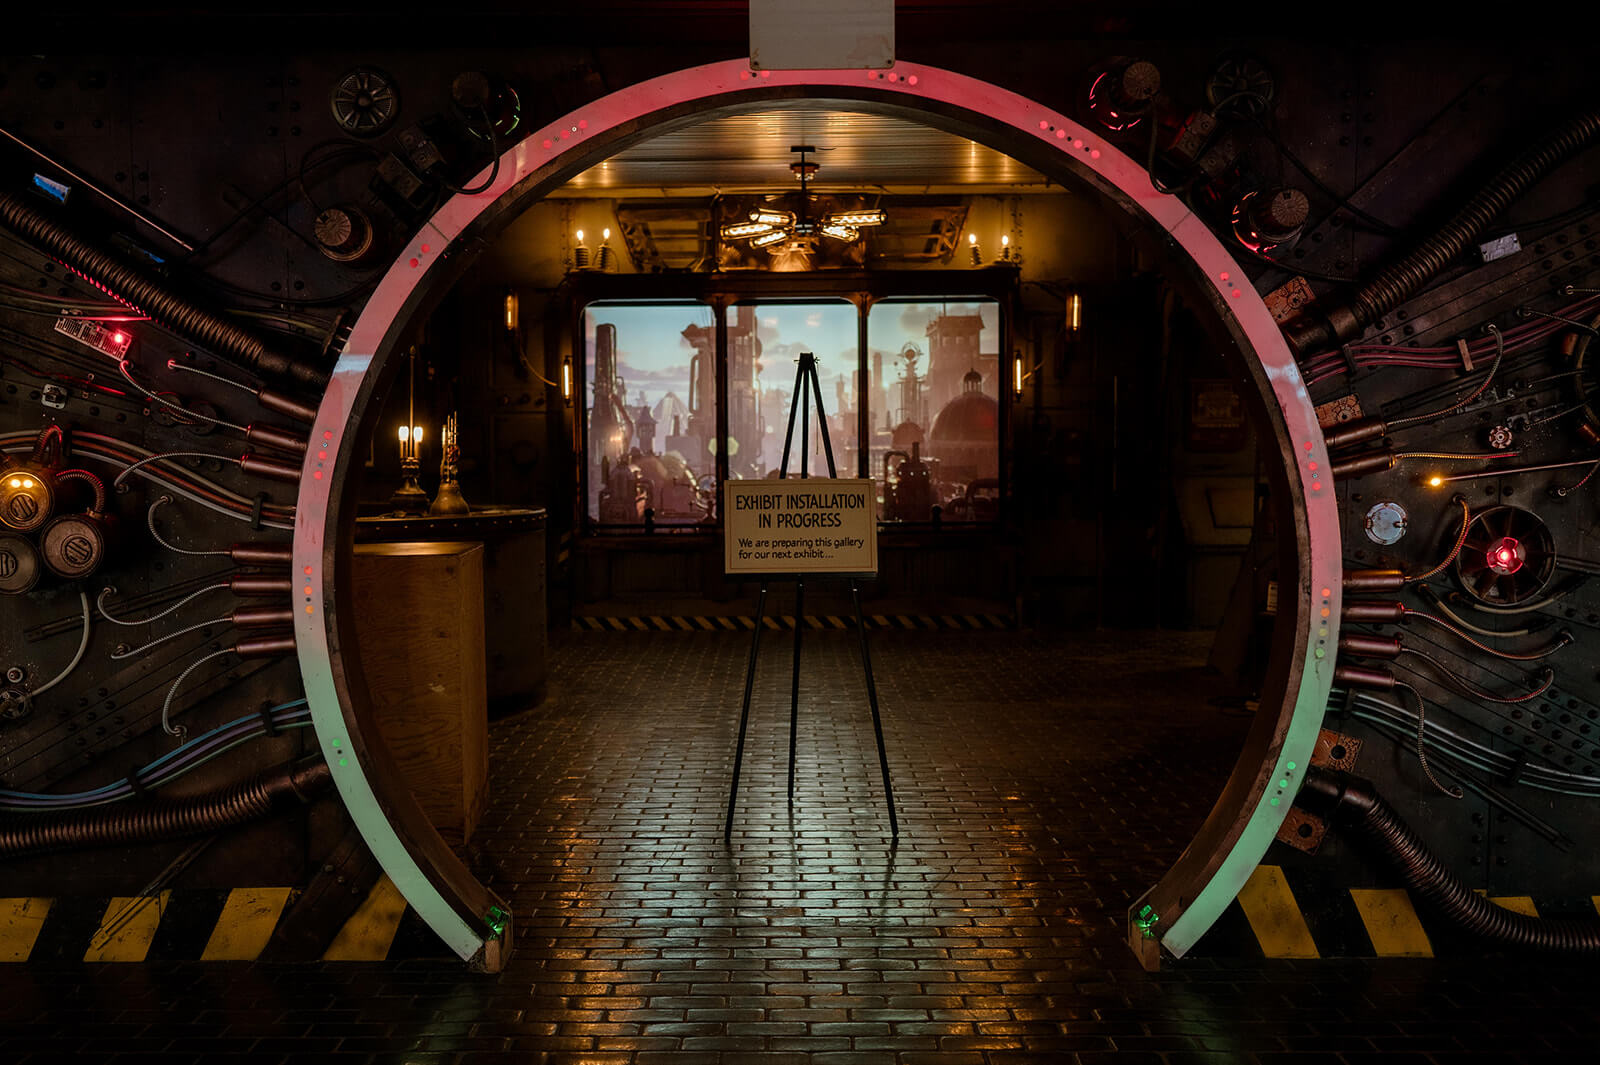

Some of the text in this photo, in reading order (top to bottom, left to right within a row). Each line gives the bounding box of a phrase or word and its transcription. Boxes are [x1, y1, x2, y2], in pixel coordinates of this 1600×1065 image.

[736, 494, 865, 510] EXHIBIT INSTALLATION
[758, 513, 842, 528] IN PROGRESS
[738, 536, 864, 550] We are preparing this gallery
[738, 550, 752, 559] for
[754, 551, 770, 559] our
[772, 550, 791, 559] next
